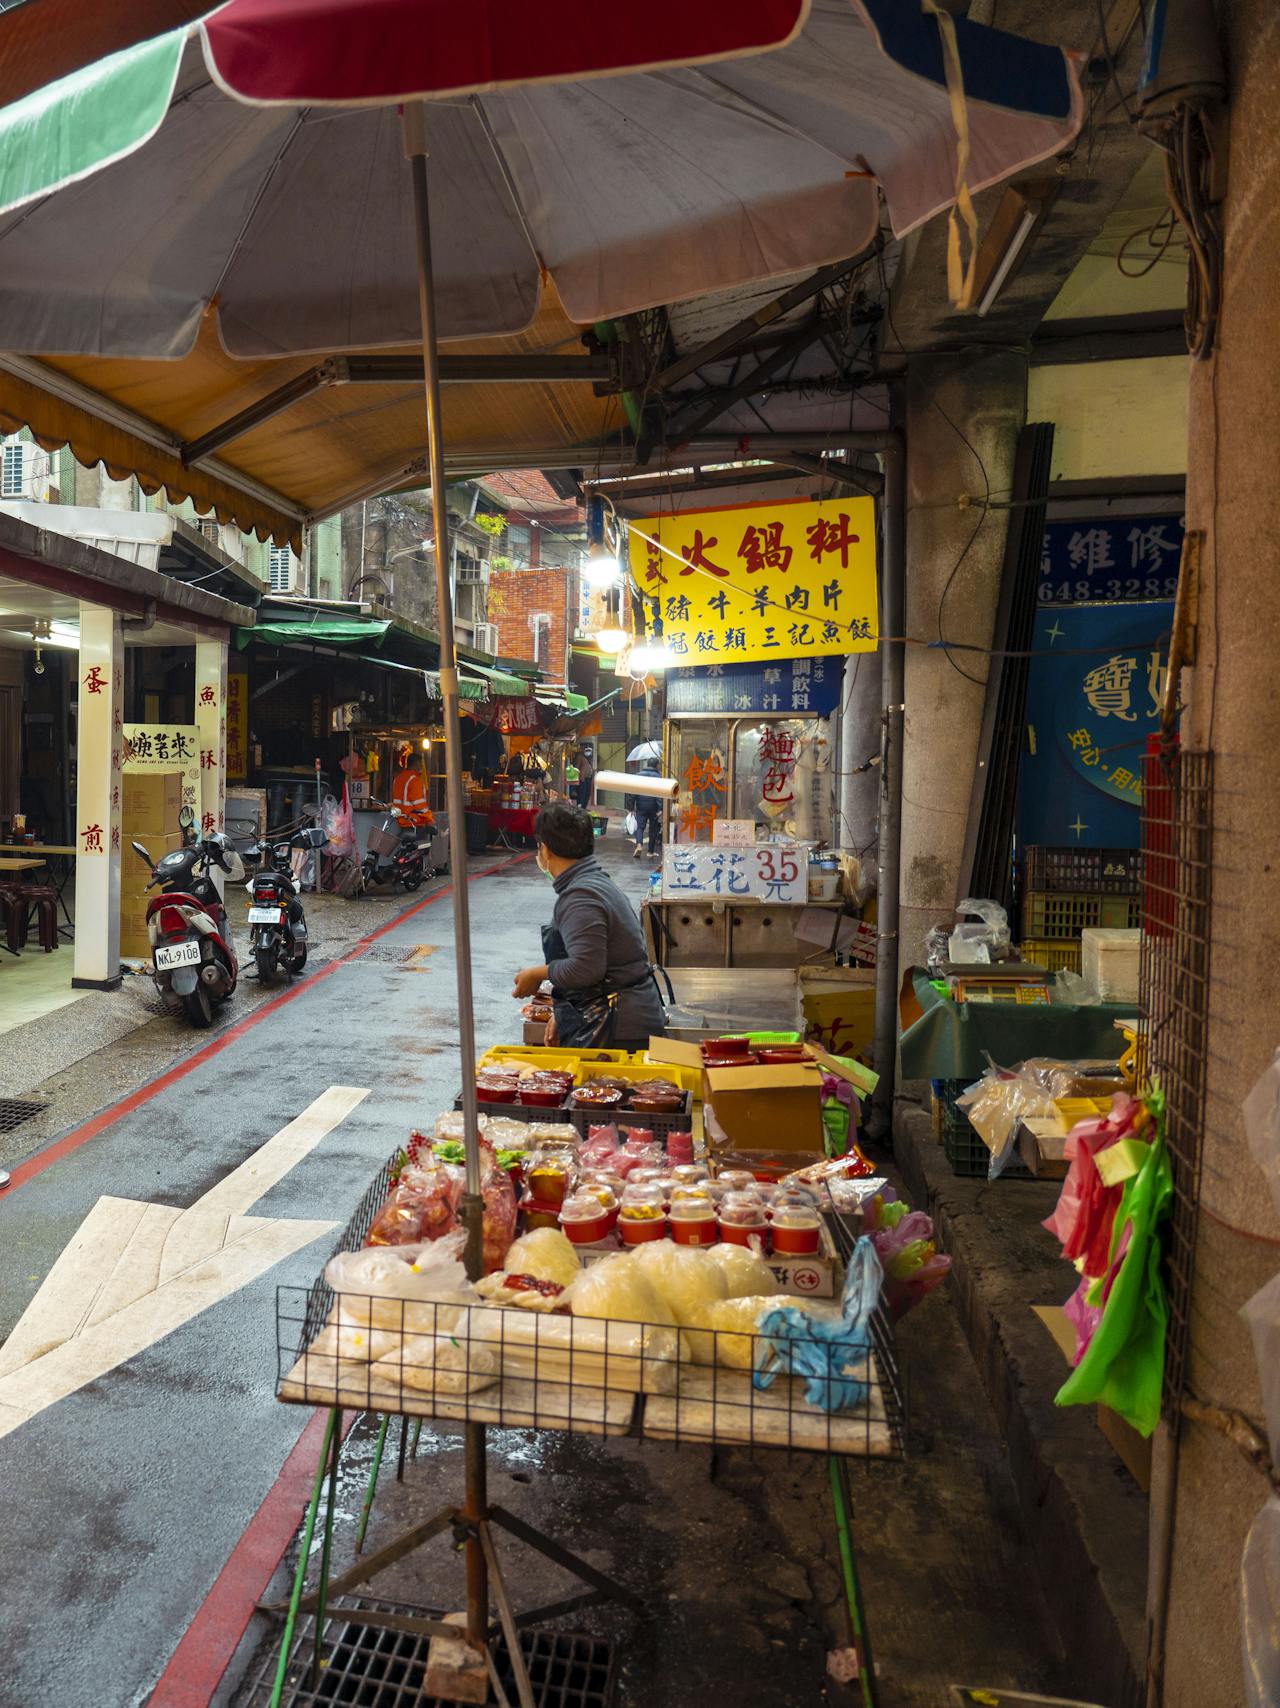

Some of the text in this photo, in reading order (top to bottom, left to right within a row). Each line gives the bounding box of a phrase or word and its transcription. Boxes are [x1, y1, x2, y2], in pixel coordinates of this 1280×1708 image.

[645, 513, 860, 584] 日式 火鍋料
[80, 667, 109, 853] 蛋 煎
[759, 728, 795, 803] 麵包
[756, 850, 799, 883] 35
[765, 878, 793, 902] 元
